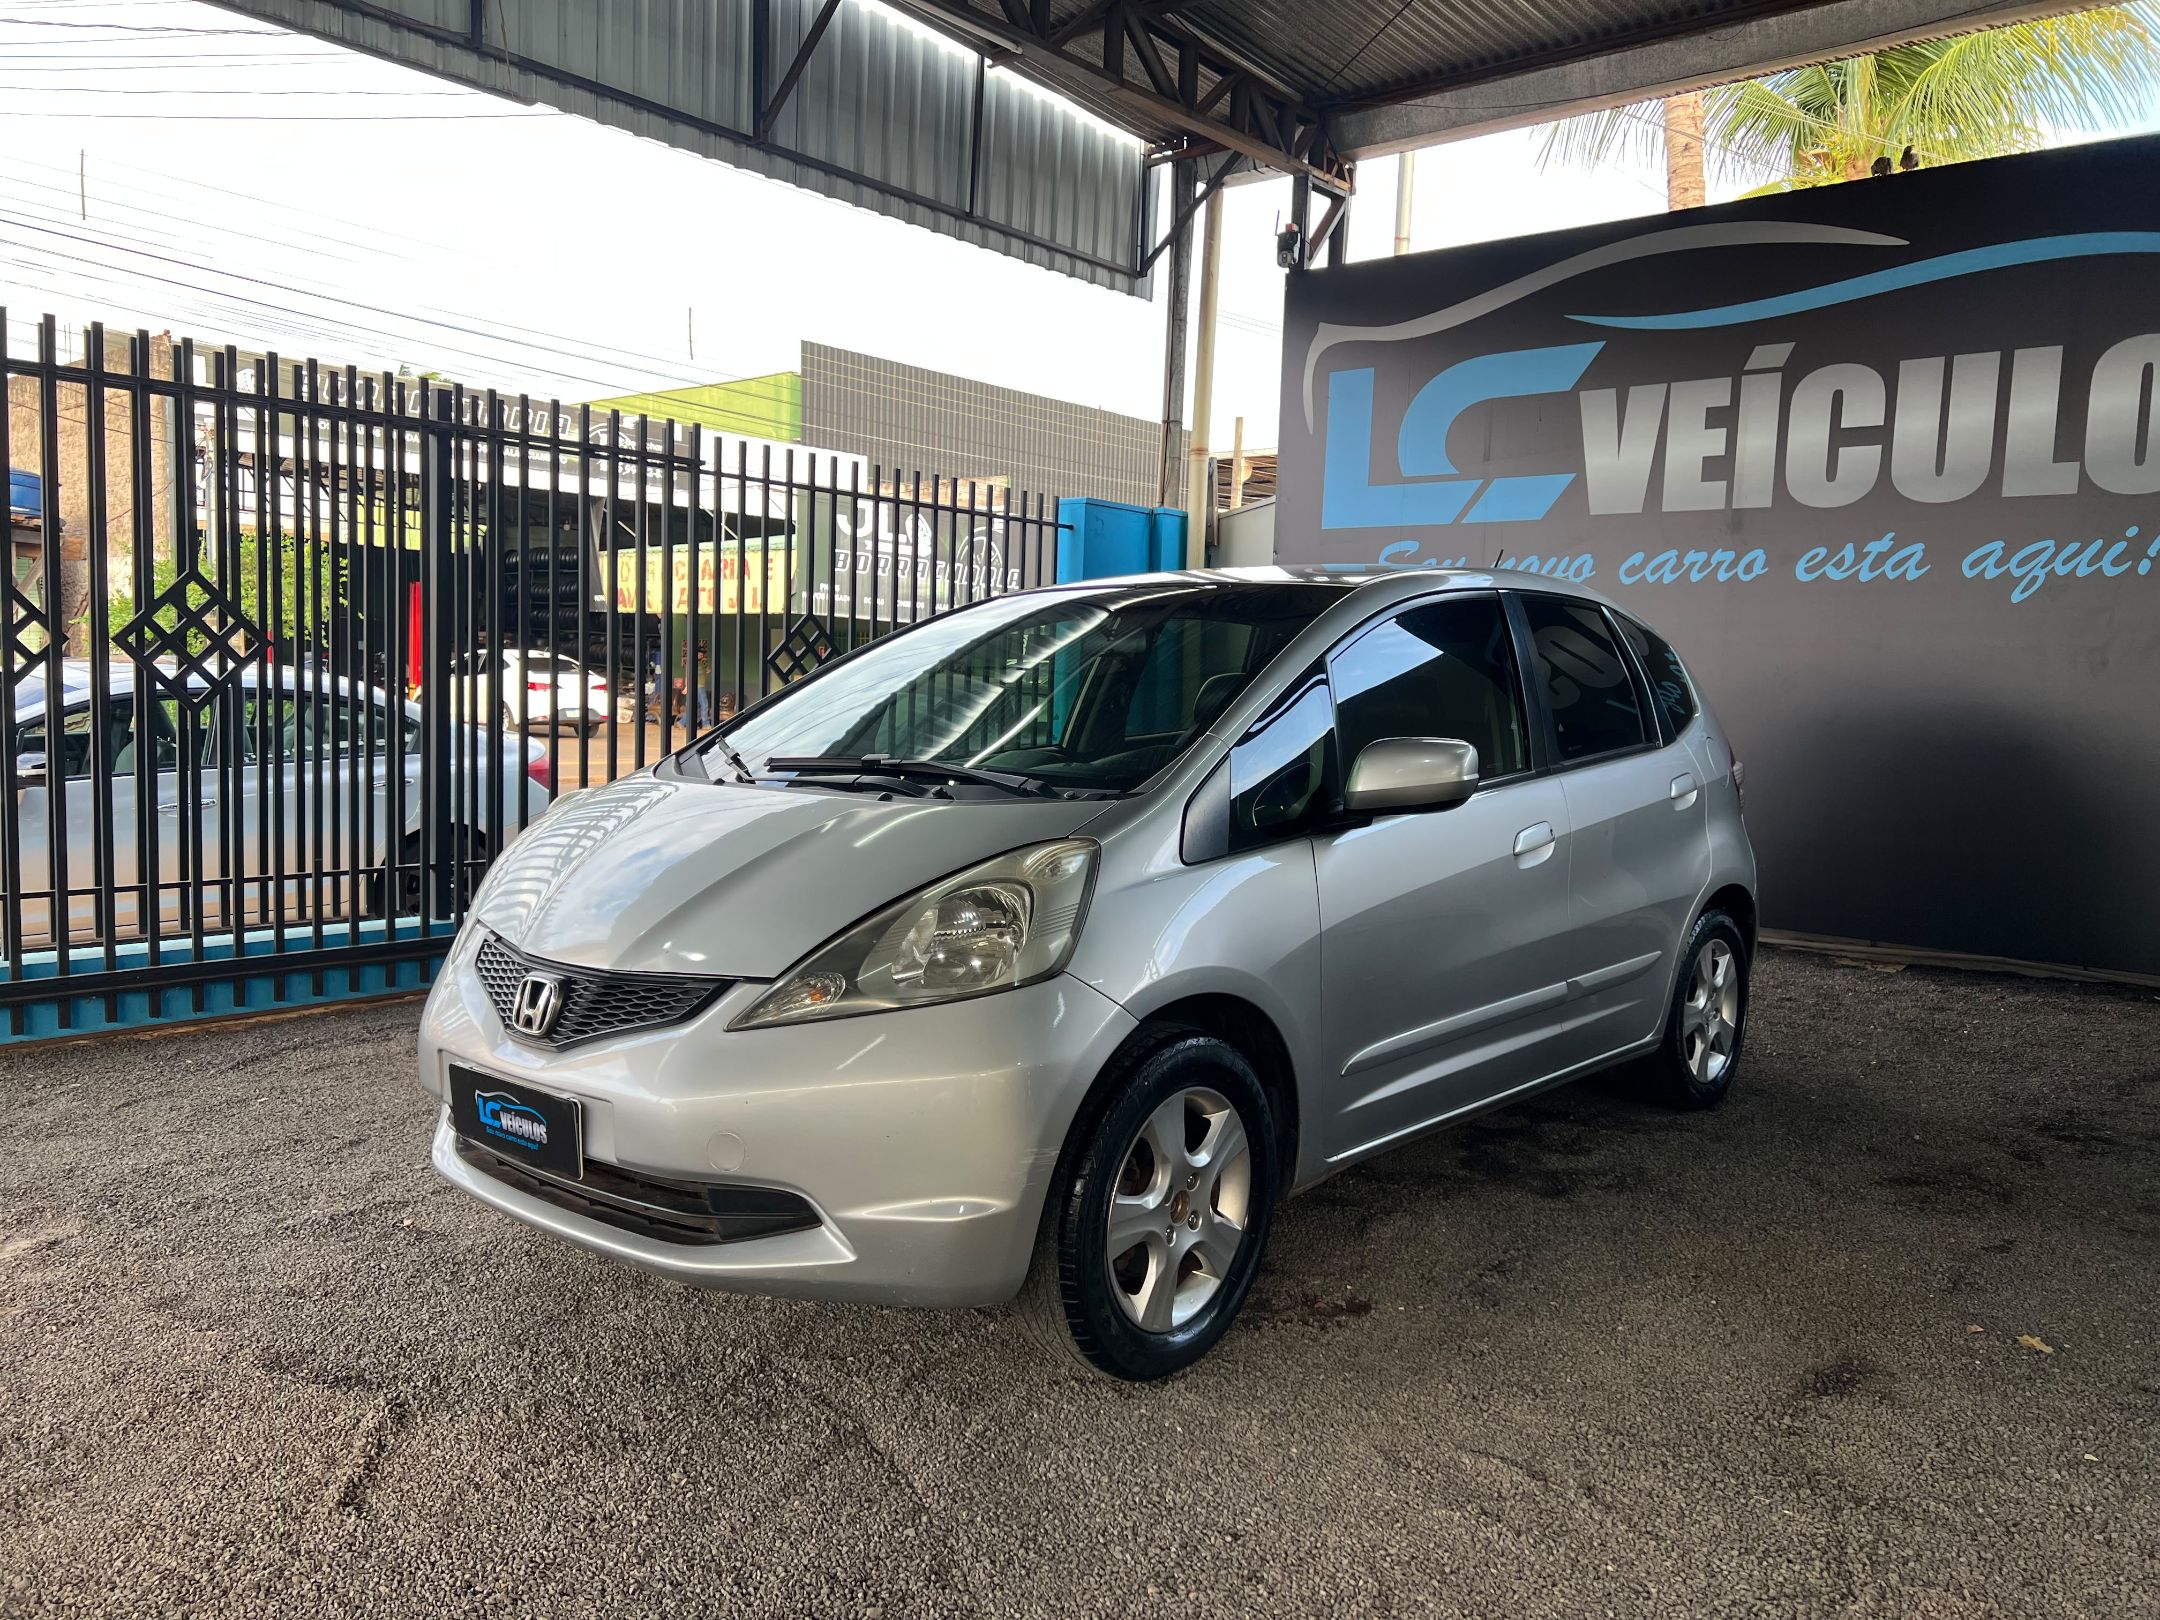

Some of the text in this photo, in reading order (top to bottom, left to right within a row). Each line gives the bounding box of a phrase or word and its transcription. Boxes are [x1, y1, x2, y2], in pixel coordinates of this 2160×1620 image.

[1321, 340, 1606, 529] LC
[1619, 541, 1768, 584] carro
[478, 1096, 502, 1129] LC
